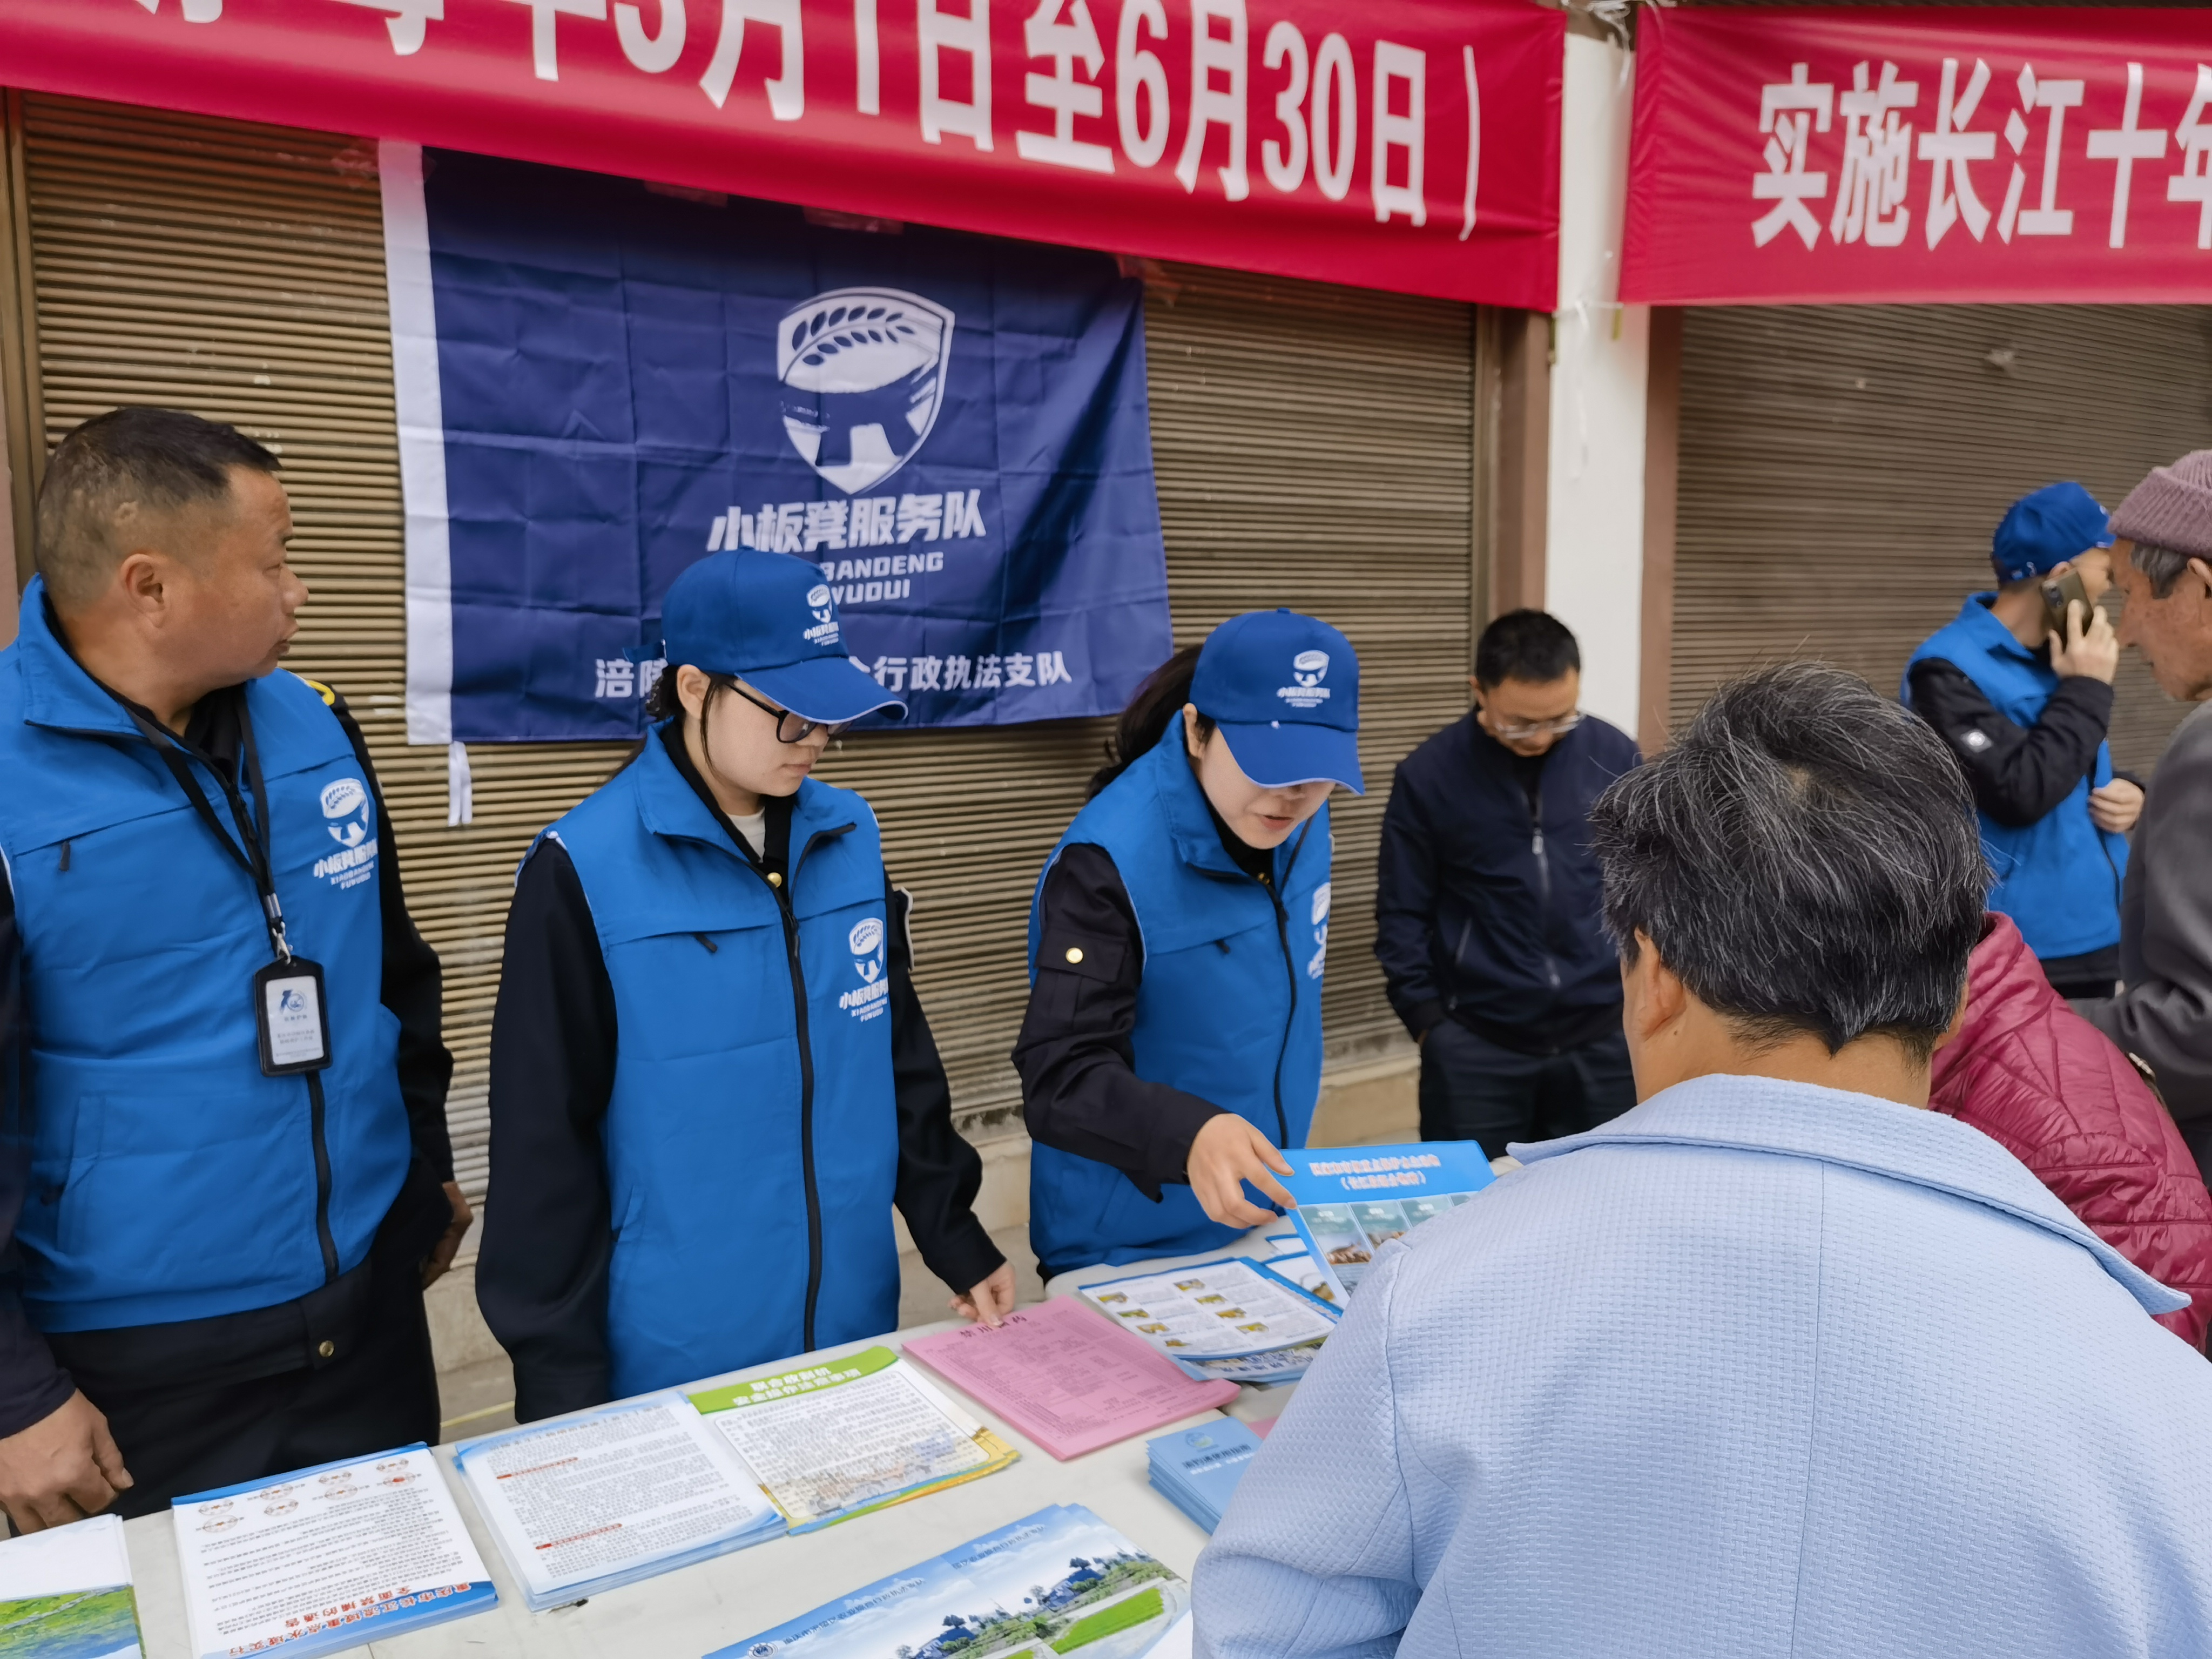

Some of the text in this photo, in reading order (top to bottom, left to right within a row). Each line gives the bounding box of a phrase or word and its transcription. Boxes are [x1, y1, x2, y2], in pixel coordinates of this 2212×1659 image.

[1751, 58, 2212, 251] 实施长江十年
[706, 489, 987, 553] 小板凳服务队
